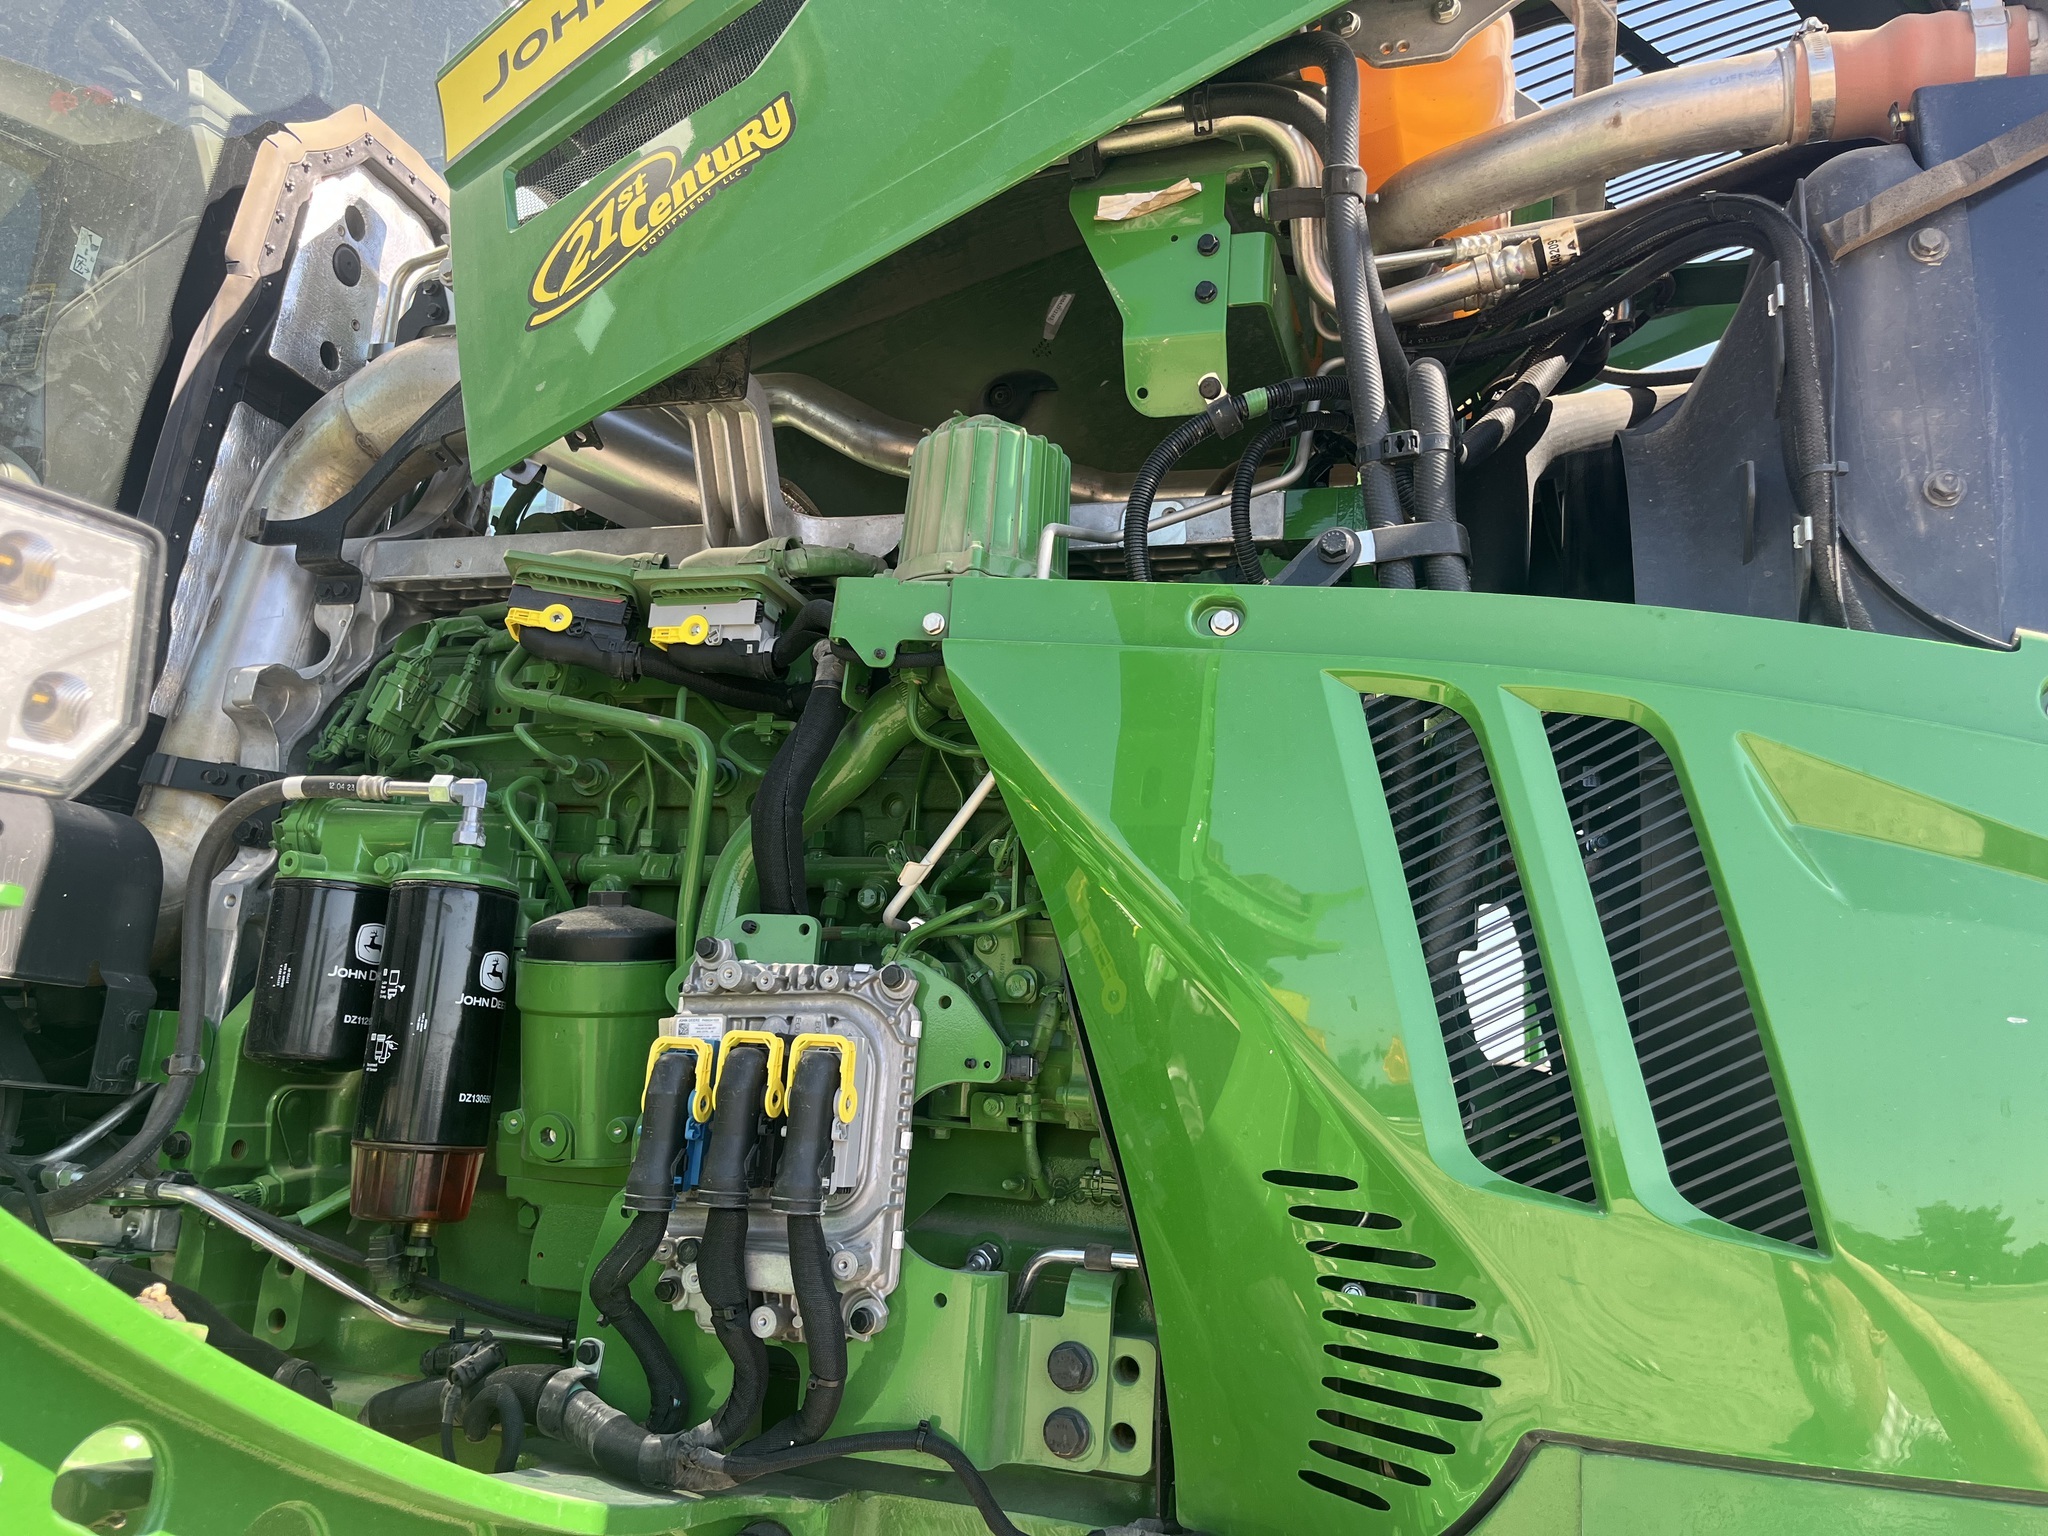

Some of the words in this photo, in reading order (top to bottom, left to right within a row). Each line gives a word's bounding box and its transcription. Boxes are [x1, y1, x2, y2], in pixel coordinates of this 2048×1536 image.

[482, 0, 605, 104] JOH
[641, 188, 712, 252] EQUIPMENT
[336, 782, 345, 790] 04
[327, 964, 368, 981] JOHN
[454, 992, 490, 1008] JOHN
